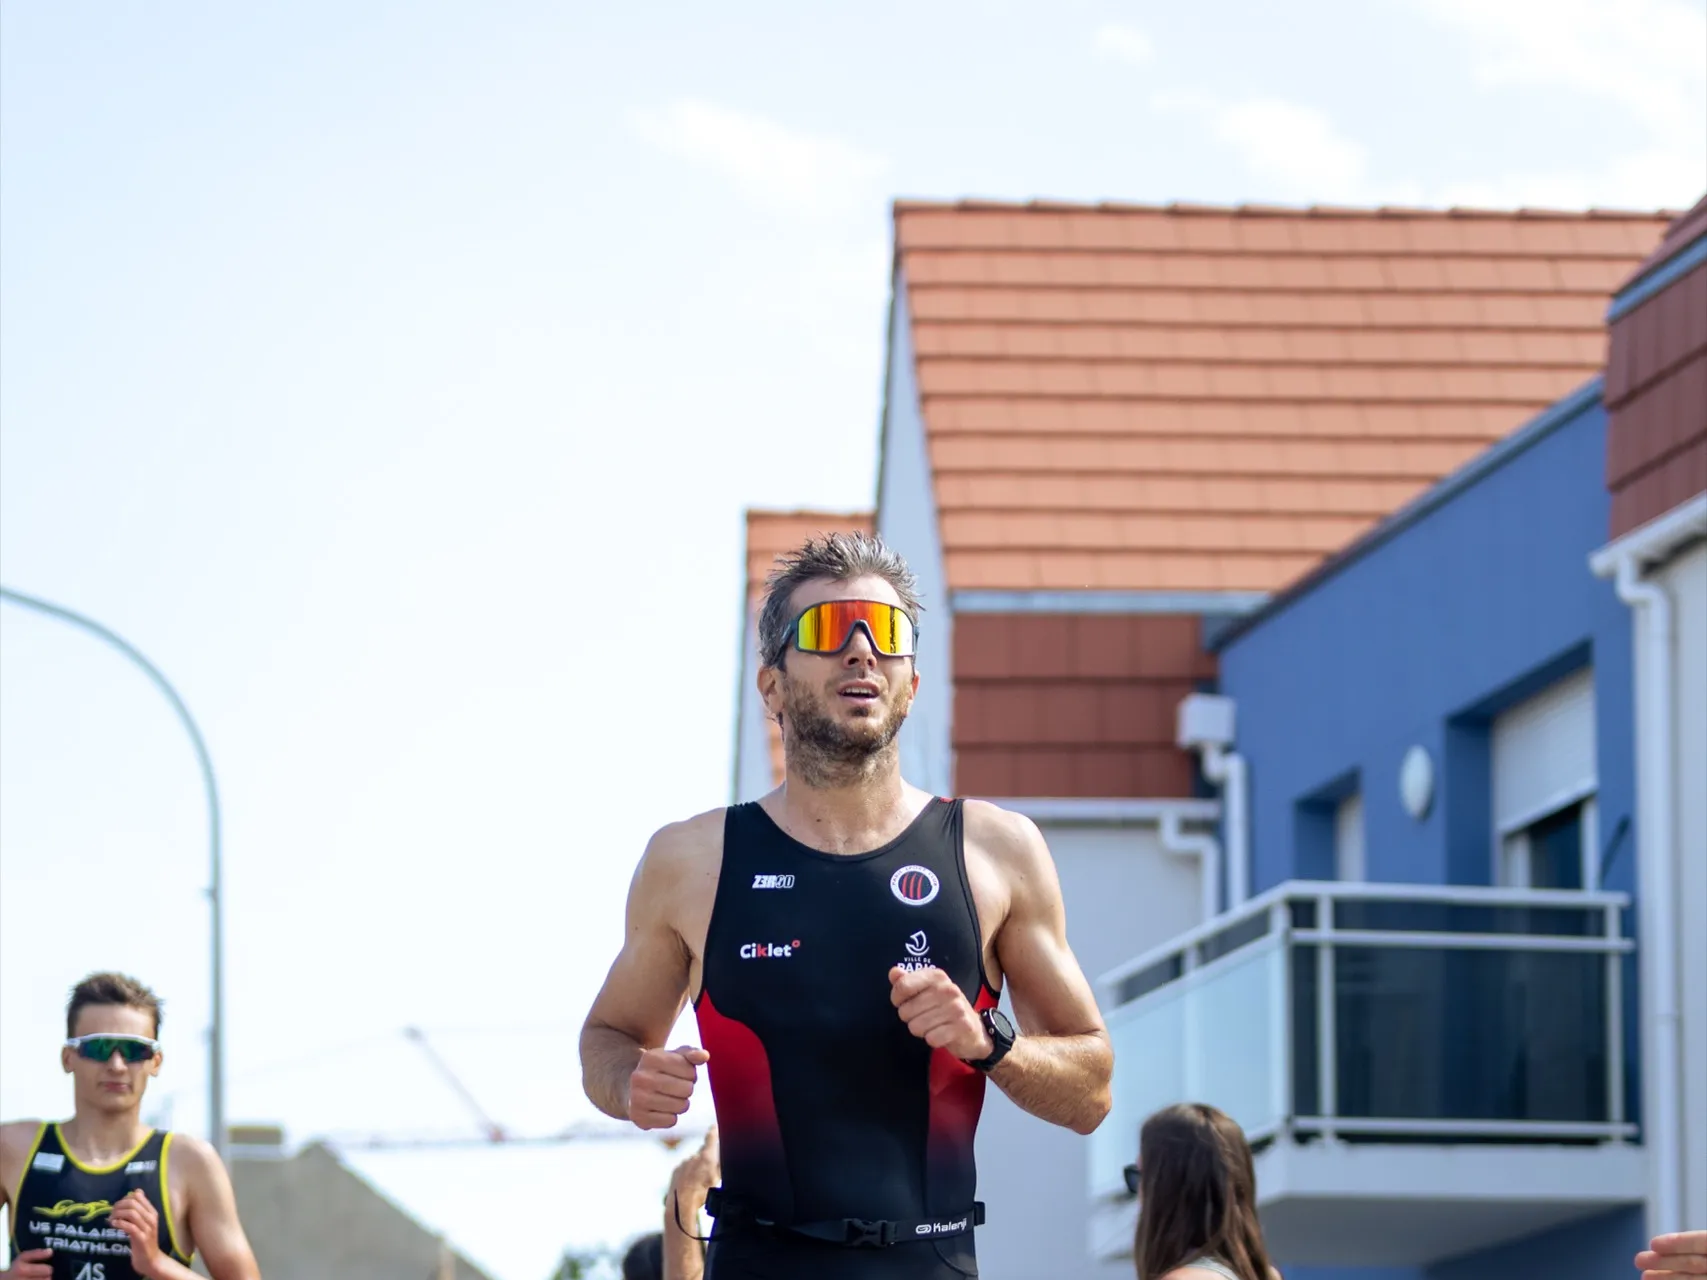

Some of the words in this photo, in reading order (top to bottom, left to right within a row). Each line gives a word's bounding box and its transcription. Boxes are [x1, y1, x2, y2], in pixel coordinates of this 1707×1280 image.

[29, 1221, 51, 1234] US
[55, 1223, 131, 1239] PALAISE
[933, 1218, 967, 1233] Kalenji
